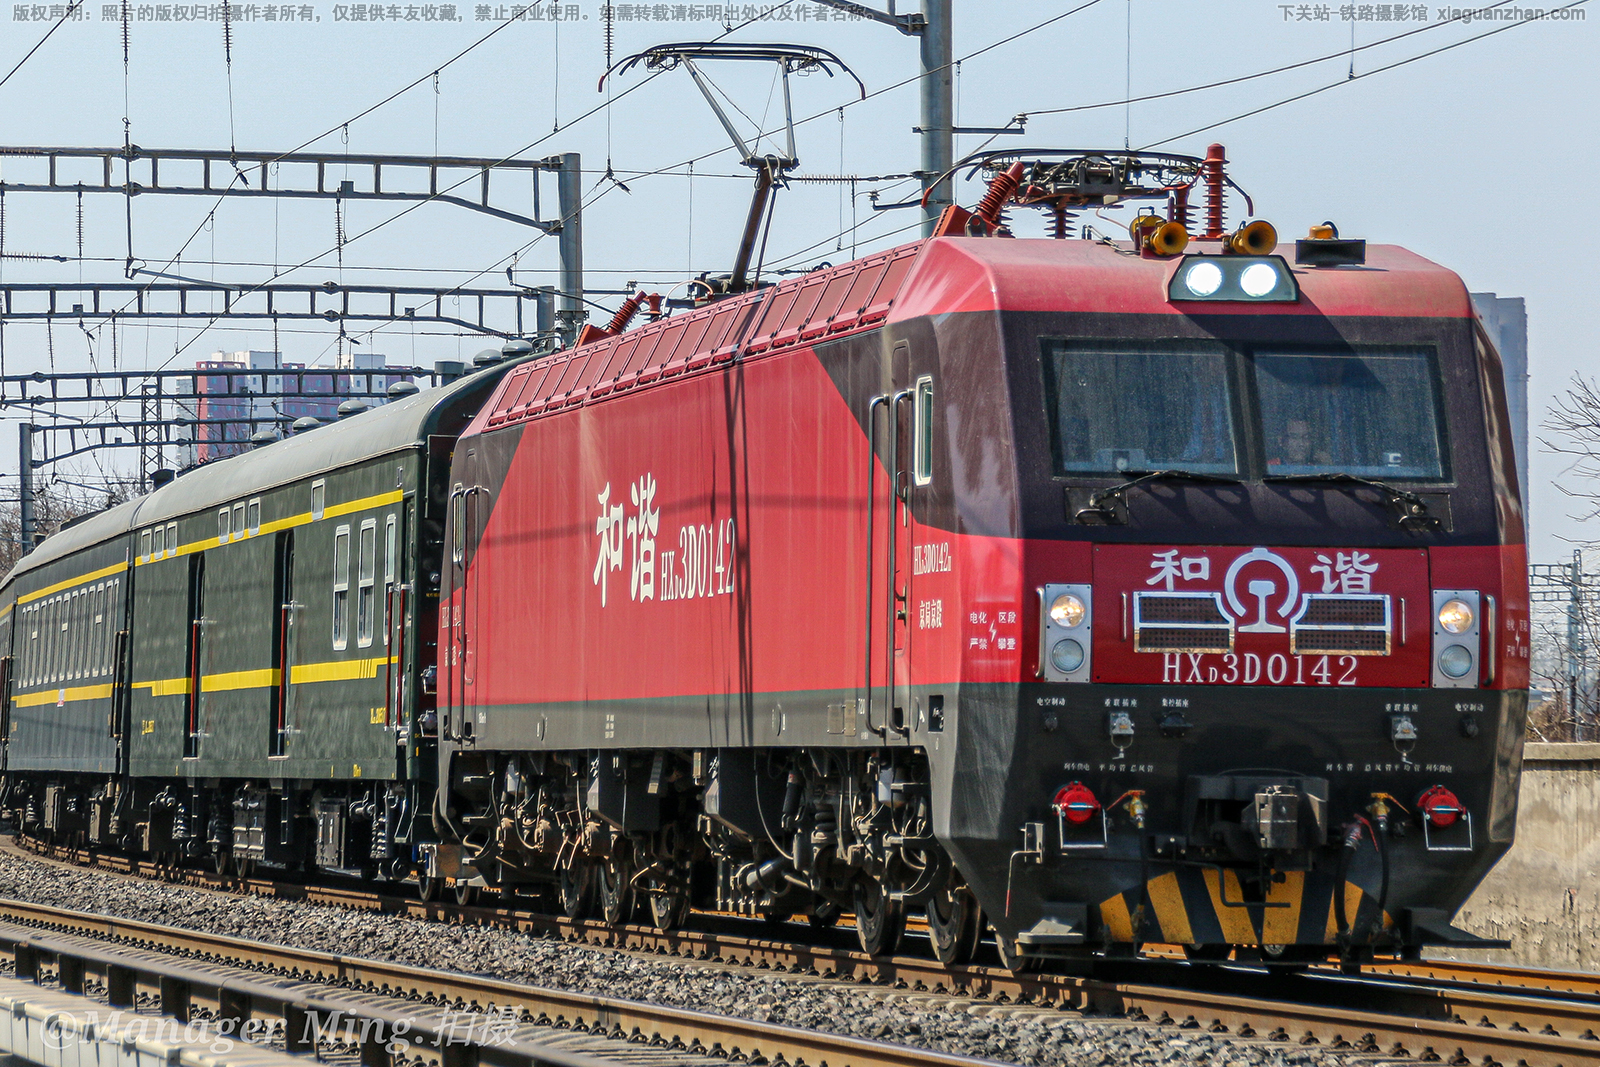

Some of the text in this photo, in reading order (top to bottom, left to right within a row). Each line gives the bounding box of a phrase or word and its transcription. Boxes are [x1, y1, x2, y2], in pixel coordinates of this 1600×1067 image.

[593, 472, 660, 608] 和谐
[1146, 549, 1379, 594] 和 谐
